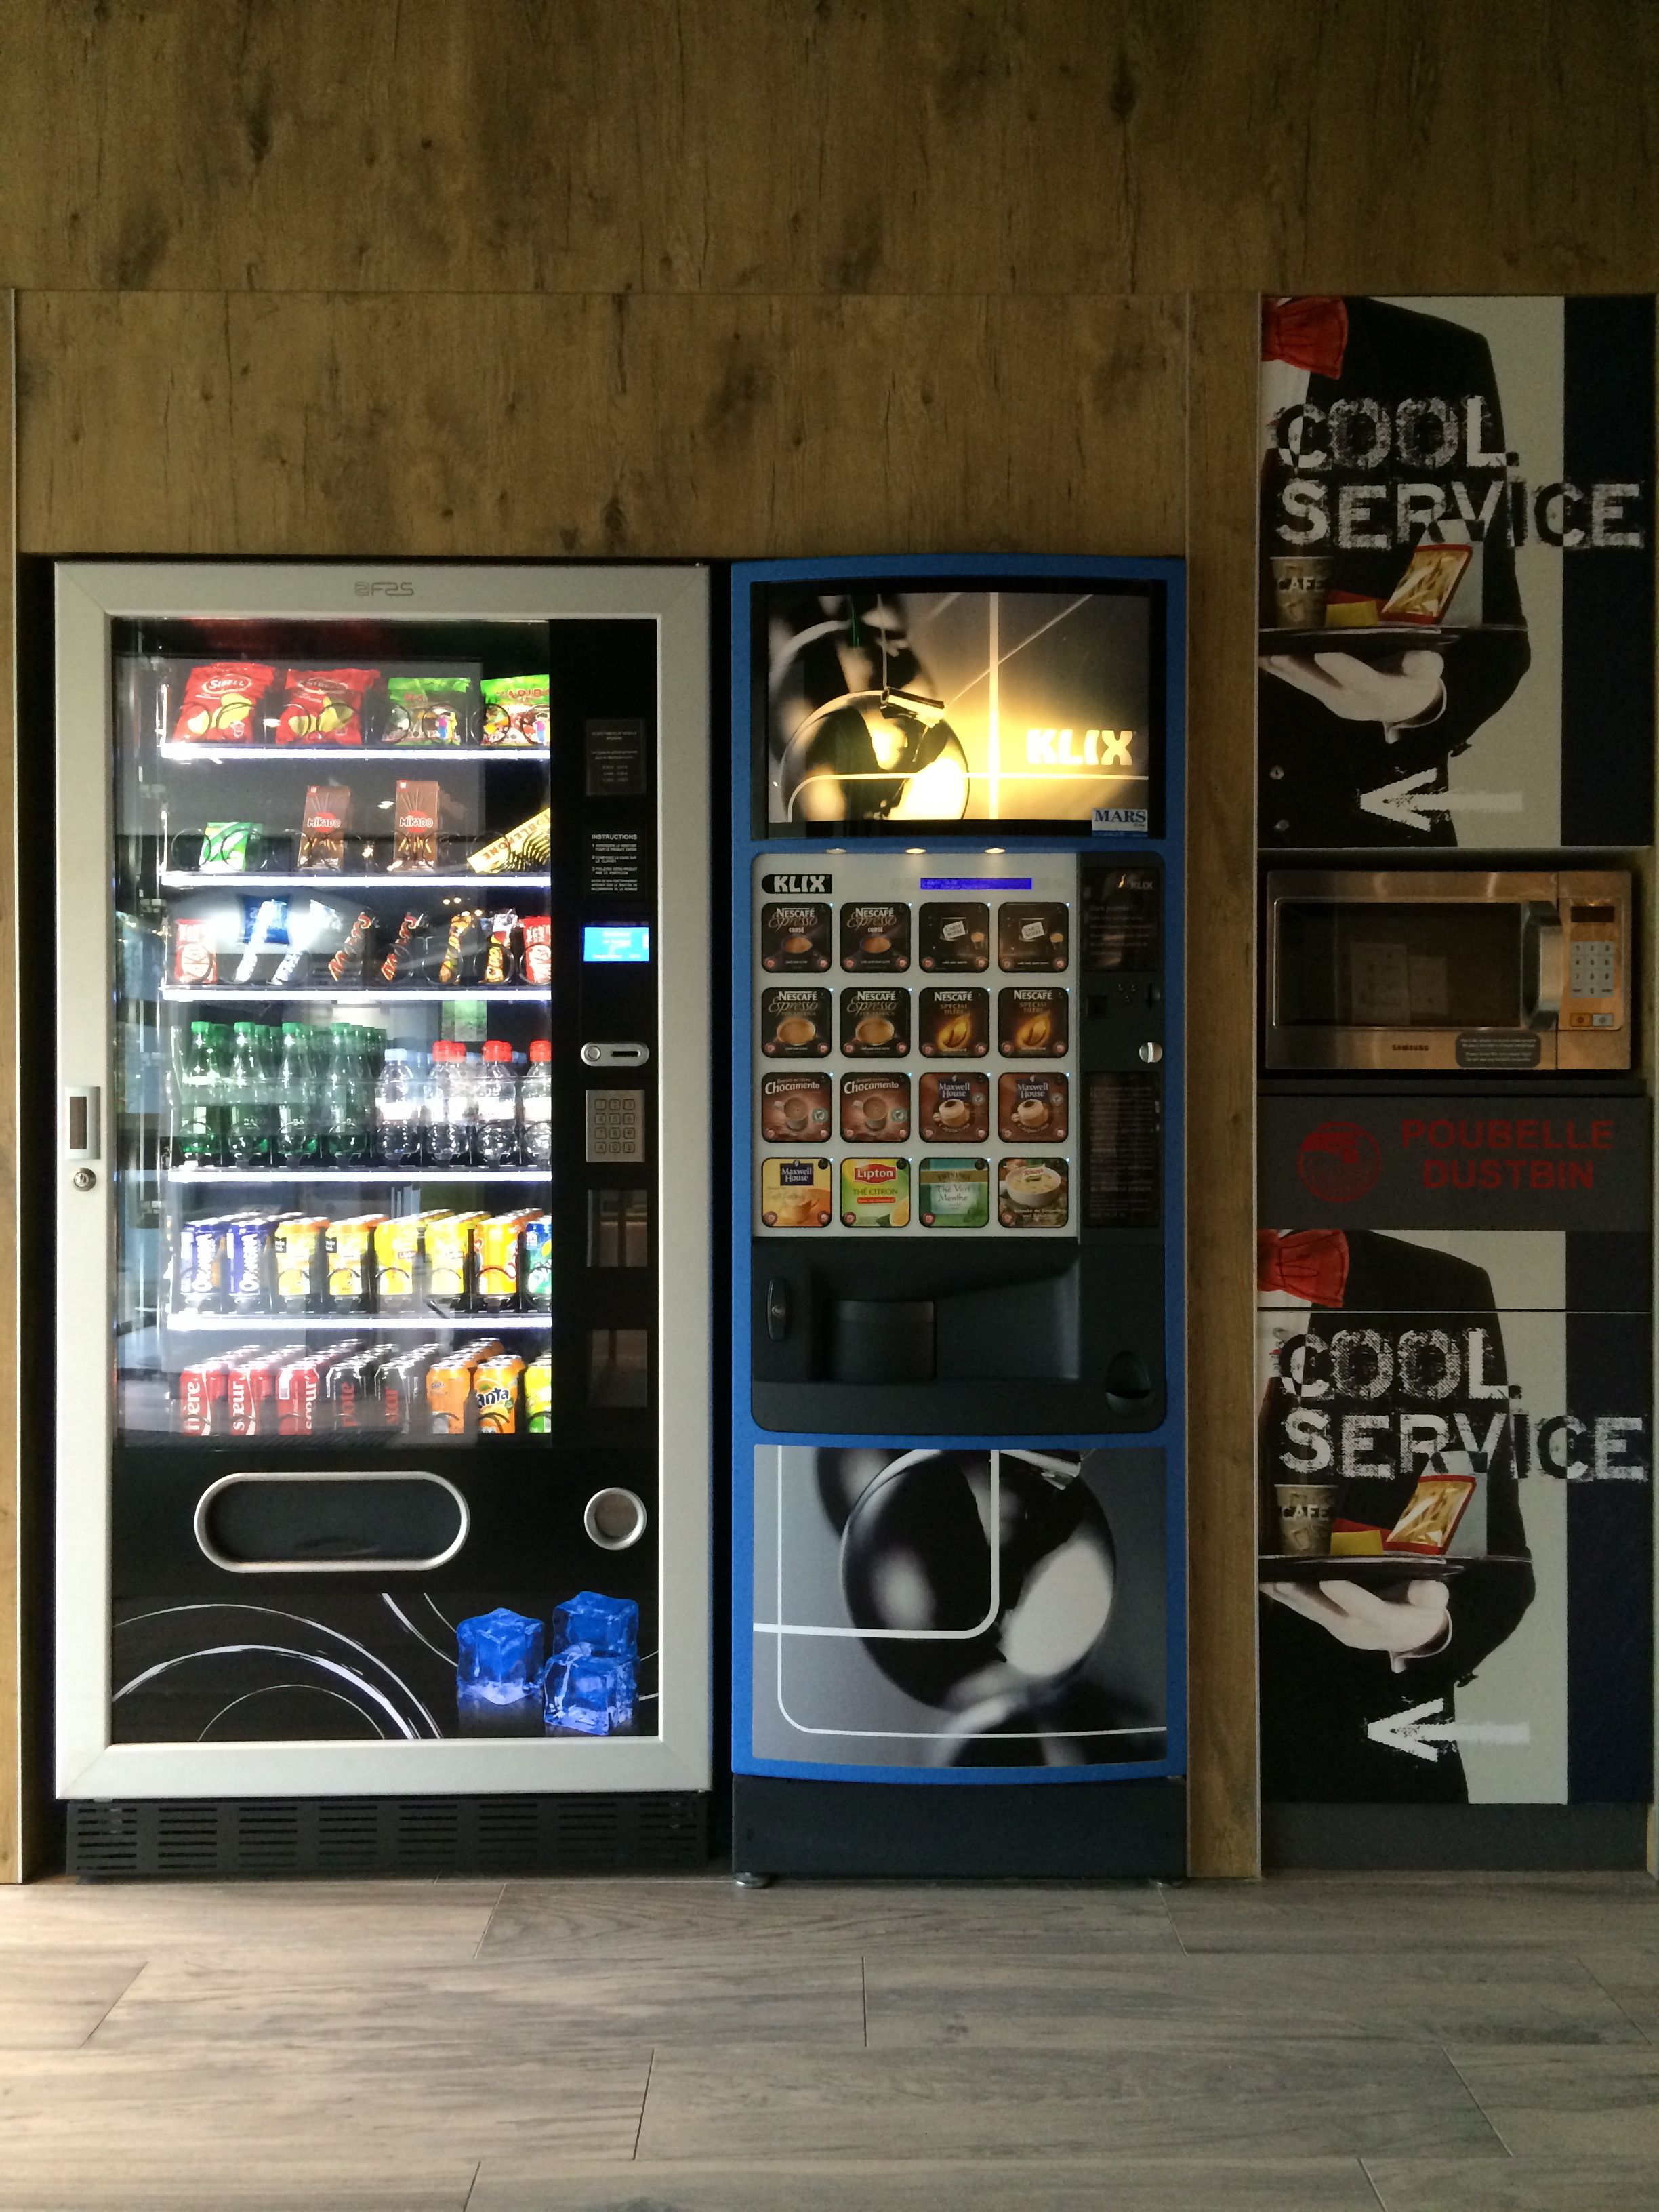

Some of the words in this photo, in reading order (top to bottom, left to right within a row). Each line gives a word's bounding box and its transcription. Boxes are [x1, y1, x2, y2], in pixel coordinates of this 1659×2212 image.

[1277, 396, 1520, 469] COOL
[1275, 478, 1645, 550] SERVICE
[1027, 729, 1134, 766] KLIX
[307, 817, 342, 828] MIKADO
[399, 816, 434, 828] MIKADO
[1094, 810, 1147, 823] MARS
[774, 876, 826, 893] KLIX
[934, 991, 973, 1002] NESCAFÉ
[1013, 989, 1052, 1000] NESCAFÉ
[765, 1081, 820, 1095] Chocamento
[844, 1081, 899, 1095] Chocamento
[939, 1082, 970, 1091] Maxwell
[1017, 1082, 1048, 1091] Maxwell
[1400, 1119, 1614, 1150] POUBELLE
[781, 1166, 813, 1176] Maxwell
[857, 1169, 894, 1181] Lipton
[1422, 1159, 1595, 1190] DUSTBIN
[785, 1174, 809, 1183] House
[853, 1187, 867, 1195] THÉ
[238, 1233, 260, 1292] ORANGINA
[1278, 1328, 1523, 1401] COOL
[476, 1387, 510, 1410] anta
[1279, 1407, 1650, 1482] SERVICE
